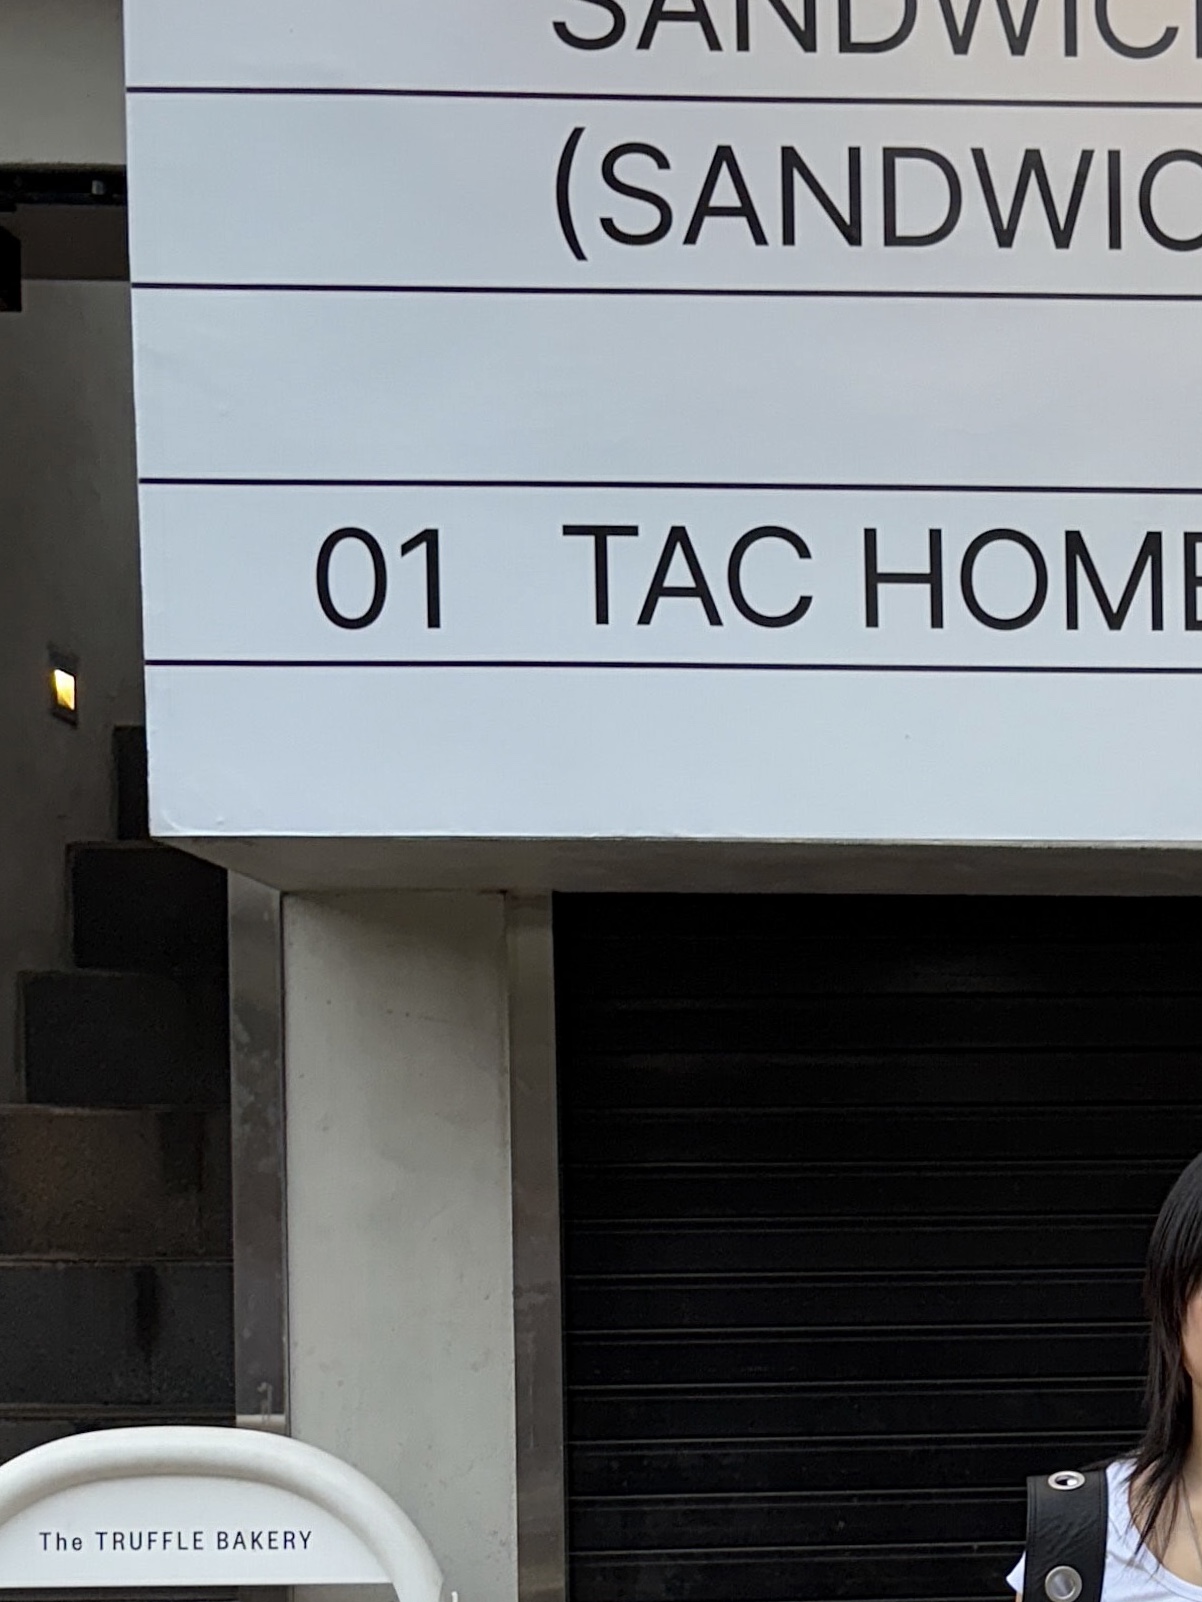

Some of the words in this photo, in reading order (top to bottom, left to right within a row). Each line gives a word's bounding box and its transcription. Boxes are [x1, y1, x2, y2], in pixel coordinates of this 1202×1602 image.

[316, 527, 441, 630] 01
[562, 525, 813, 629] TAC
[39, 1532, 83, 1551] The
[95, 1531, 204, 1551] TRUFFLE
[217, 1530, 312, 1550] BAKERY
